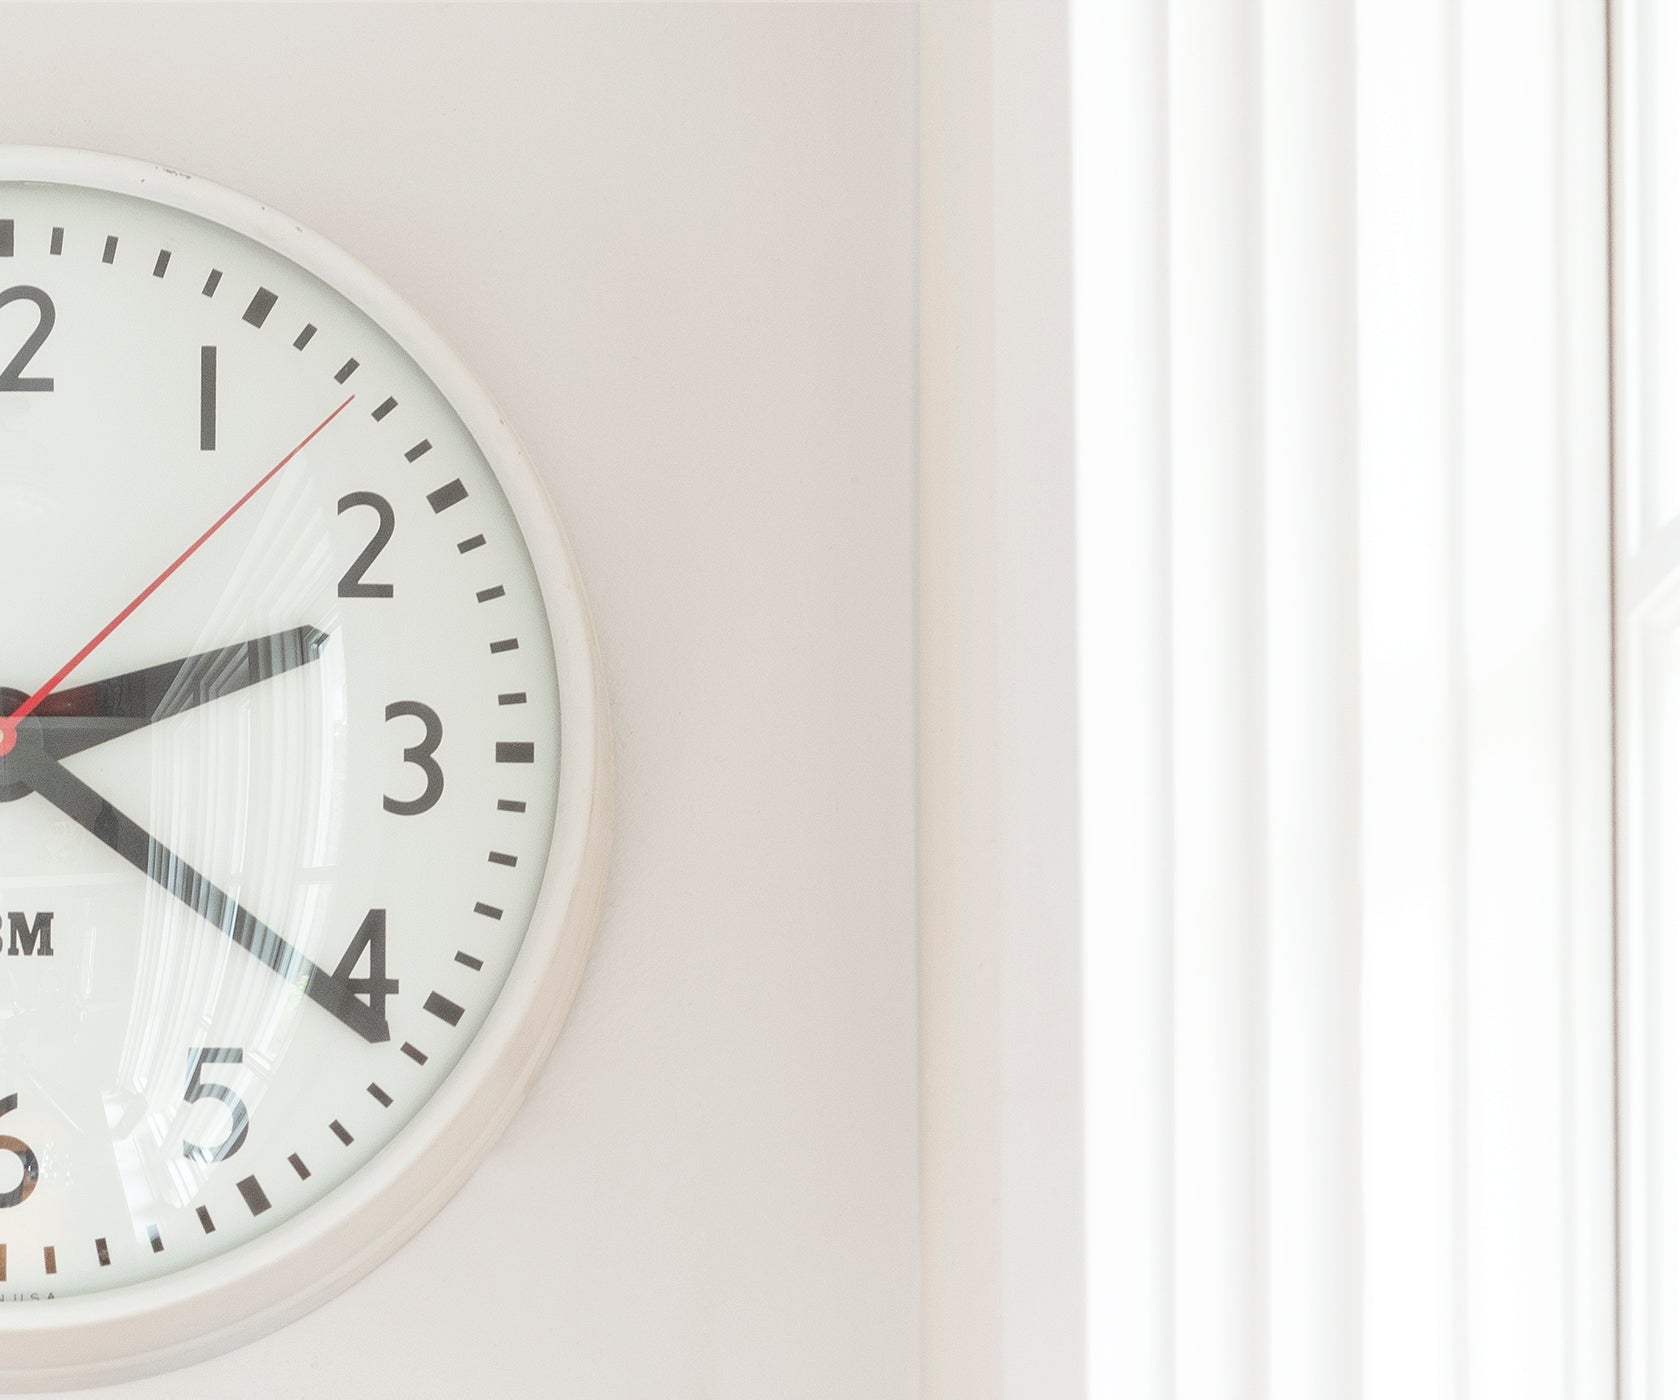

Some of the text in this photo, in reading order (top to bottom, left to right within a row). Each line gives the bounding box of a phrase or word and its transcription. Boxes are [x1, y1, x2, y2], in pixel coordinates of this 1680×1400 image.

[200, 345, 217, 451] 1
[336, 491, 396, 599] 2
[382, 700, 445, 817] 3
[332, 908, 400, 1026] 4
[183, 1047, 250, 1162] 5
